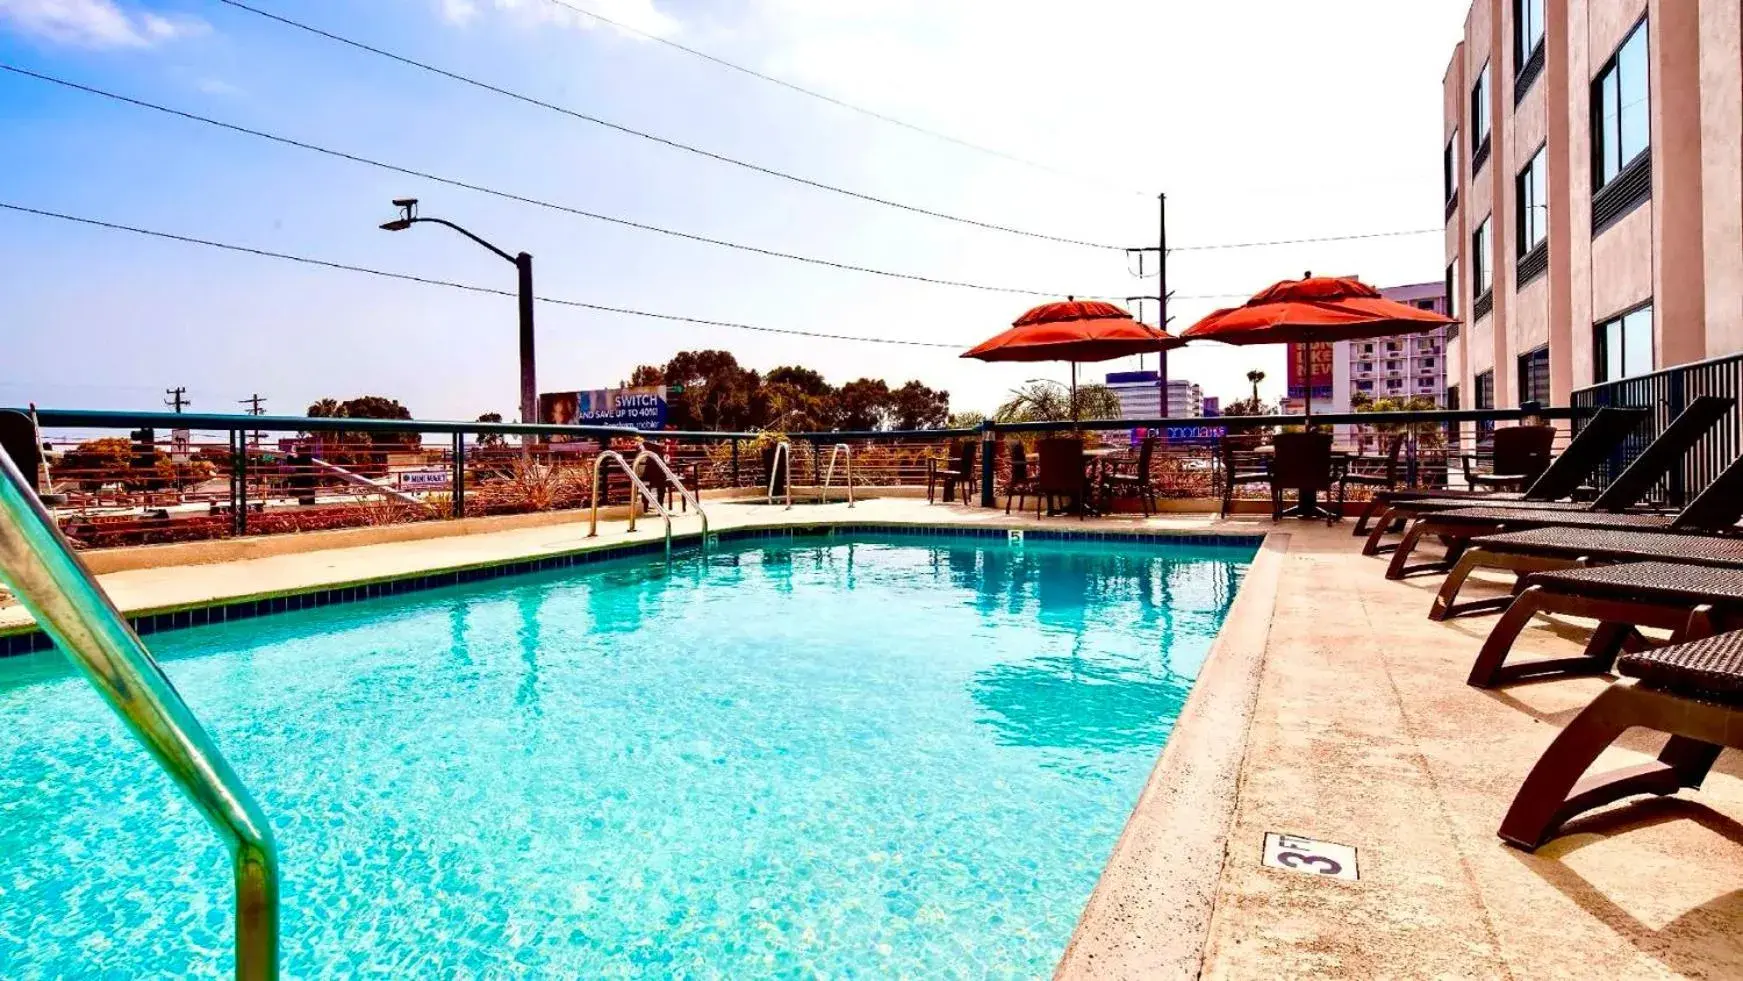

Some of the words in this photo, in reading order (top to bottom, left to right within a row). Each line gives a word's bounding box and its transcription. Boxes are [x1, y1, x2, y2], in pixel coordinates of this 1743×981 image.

[615, 395, 658, 407] SWITCH
[595, 409, 615, 419] SAVE
[616, 408, 626, 417] UP
[628, 407, 639, 417] TO
[1011, 531, 1020, 543] 5
[1277, 852, 1342, 874] 3
